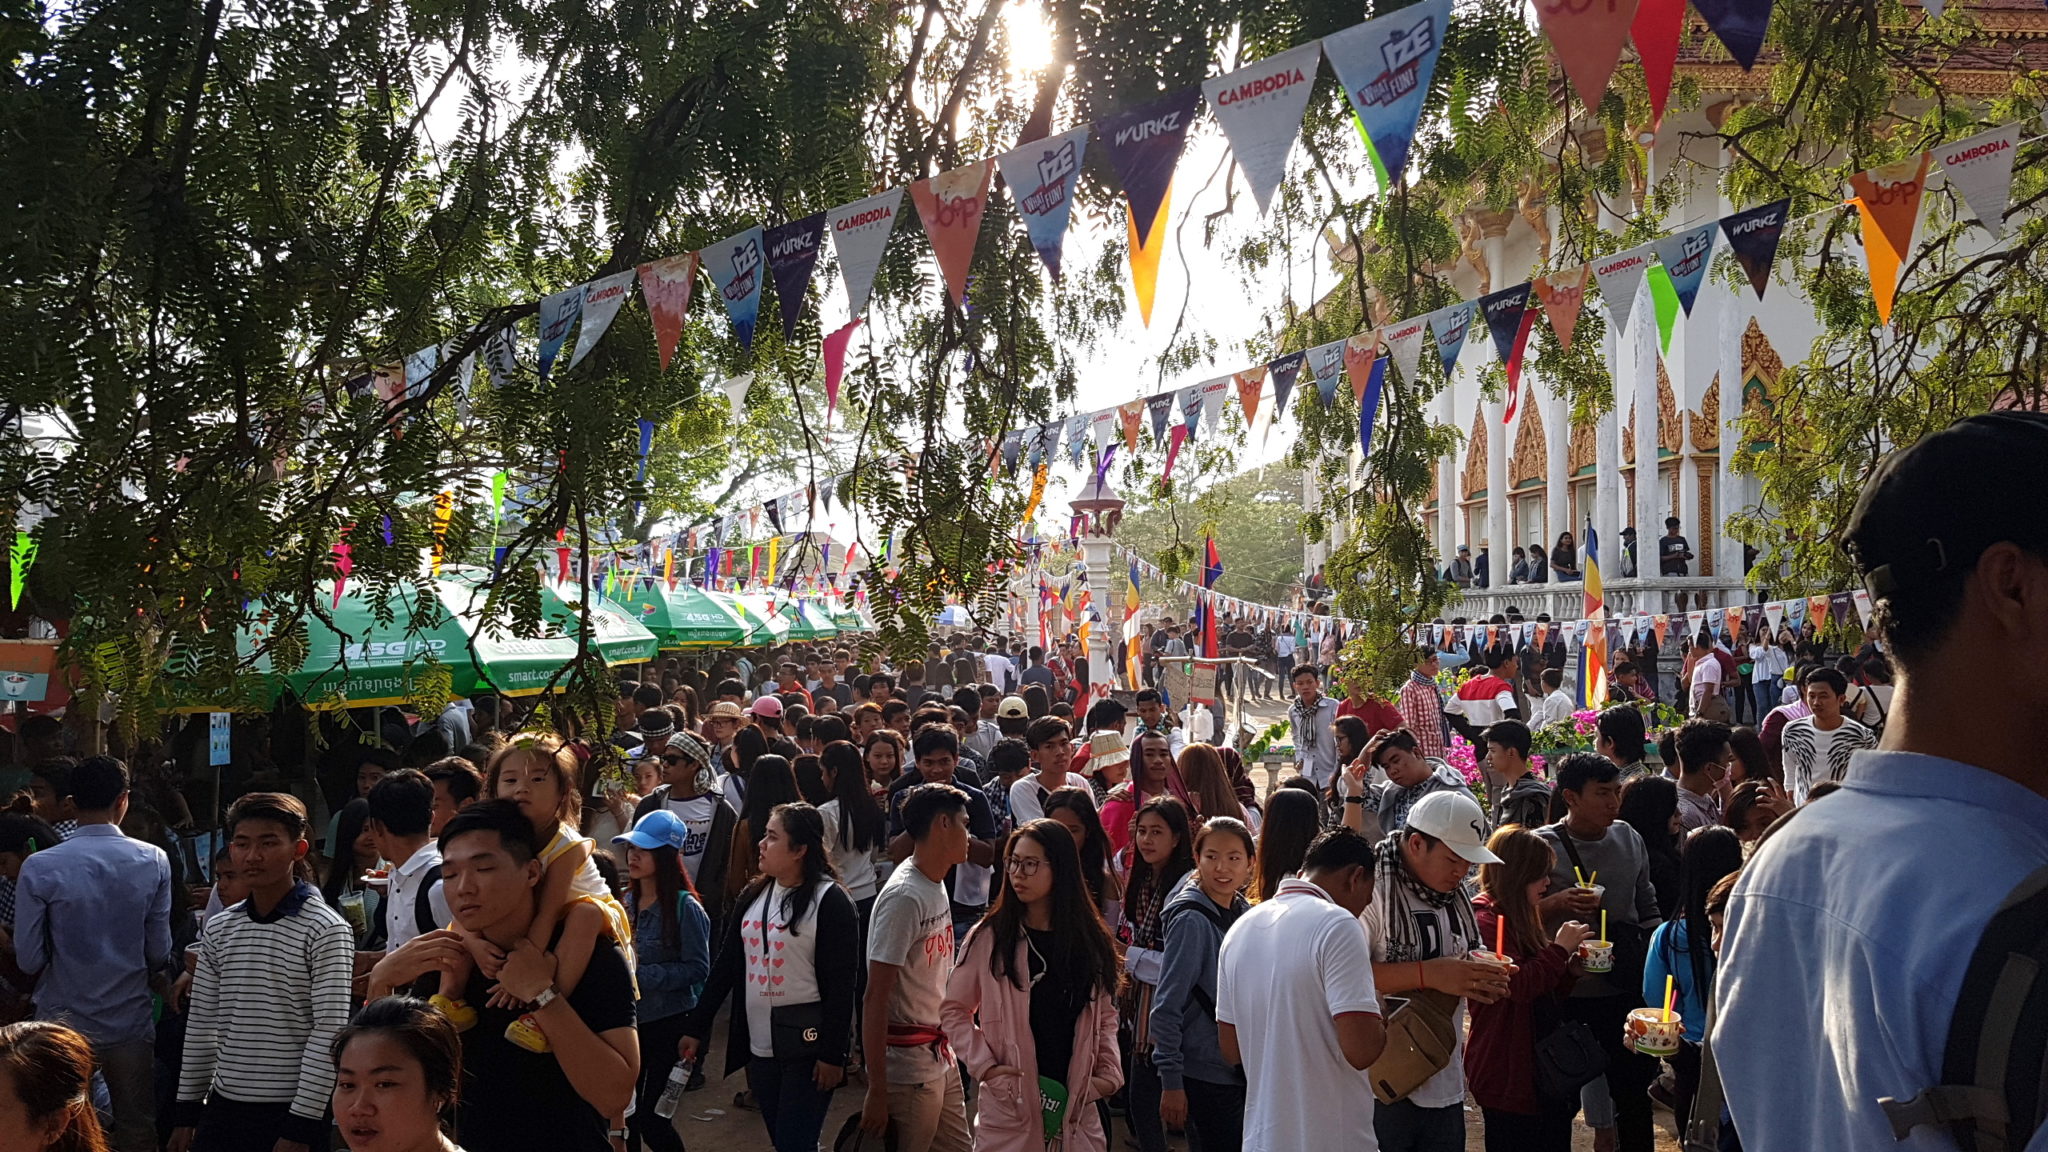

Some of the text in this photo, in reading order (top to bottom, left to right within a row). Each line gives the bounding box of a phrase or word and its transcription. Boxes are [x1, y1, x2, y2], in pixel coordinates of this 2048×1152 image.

[1218, 68, 1305, 106] CAMBODIA
[1361, 78, 1389, 105] WHAT
[1389, 68, 1415, 98] FUN!
[1115, 111, 1181, 147] WURKZ
[1946, 139, 2010, 165] CAMBODIA
[836, 206, 891, 231] CAMBODIA
[1733, 213, 1778, 236] WURKZ
[772, 232, 813, 257] WURKZ
[1598, 256, 1643, 275] CAMBODIA
[1487, 294, 1522, 312] WURKZ
[1388, 325, 1422, 341] CAMBODIA
[415, 640, 447, 651] HD
